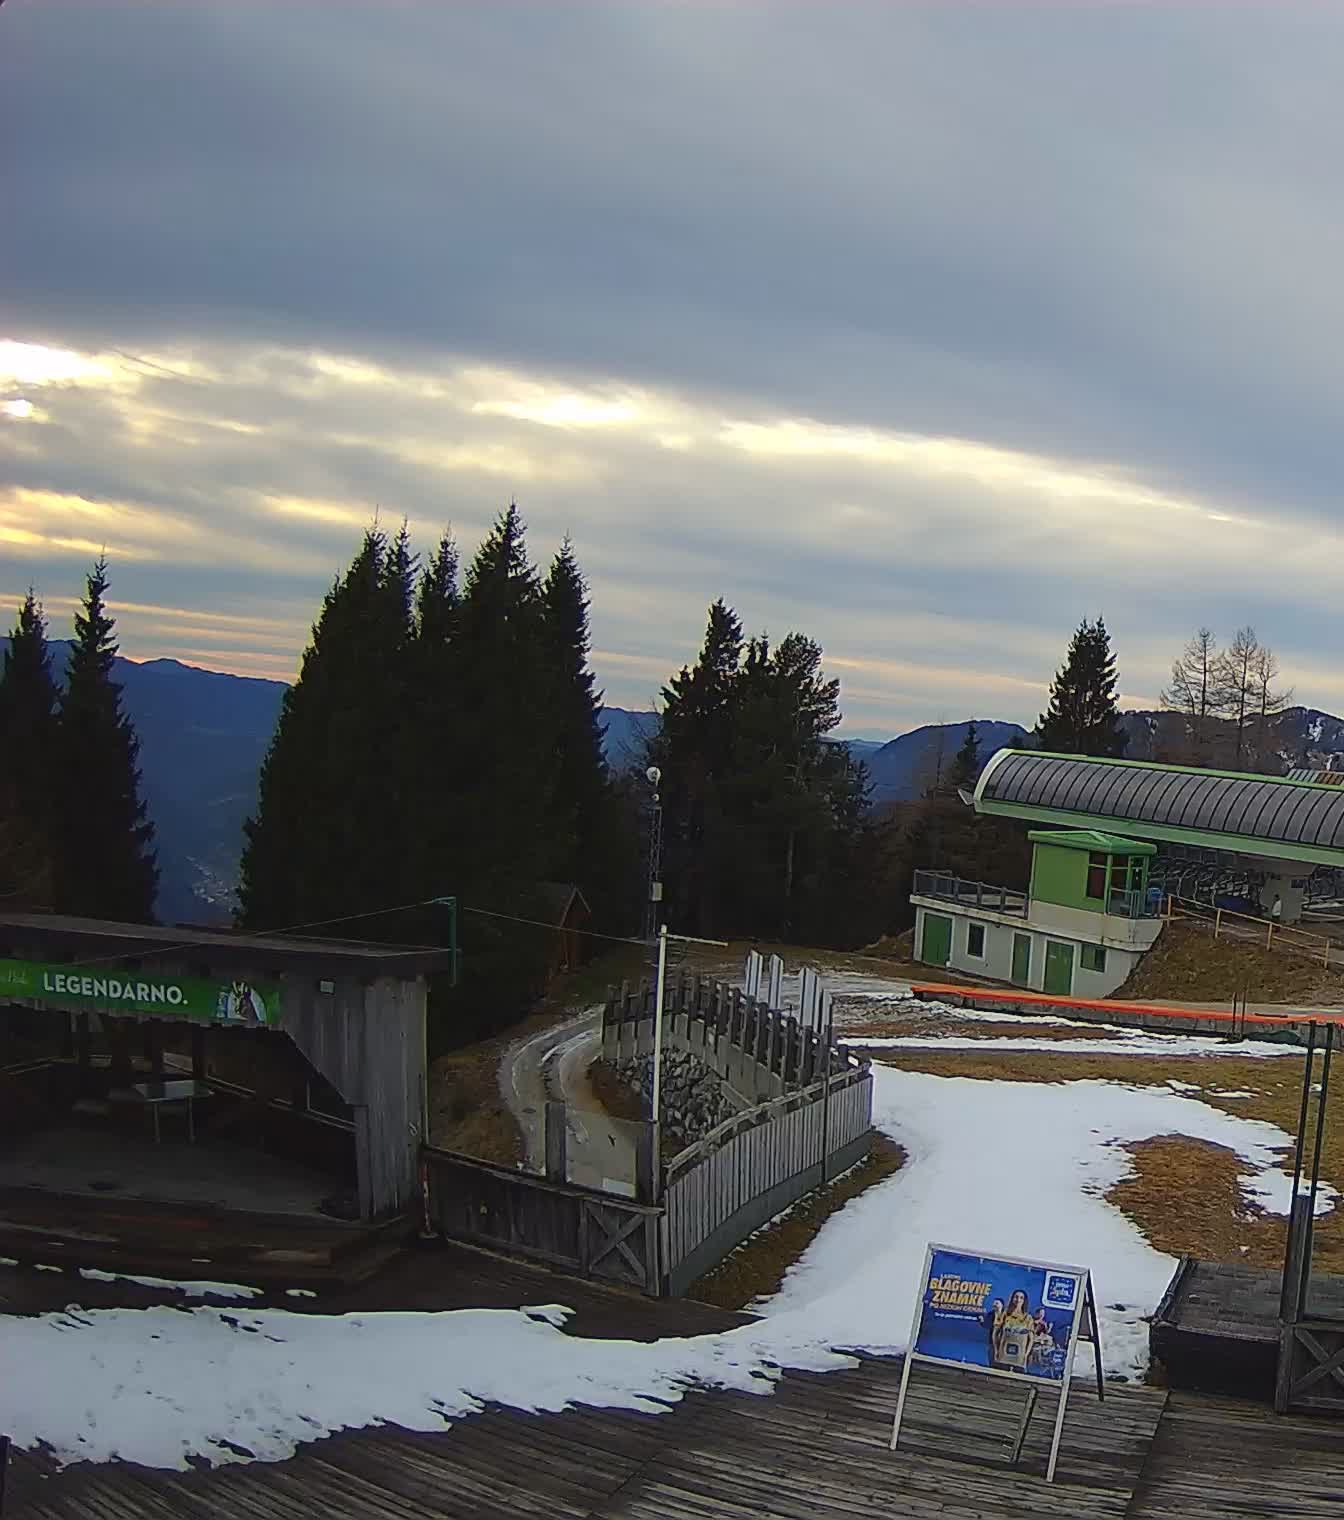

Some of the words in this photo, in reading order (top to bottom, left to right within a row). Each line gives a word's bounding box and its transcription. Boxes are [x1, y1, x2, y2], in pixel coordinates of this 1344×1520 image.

[43, 972, 189, 1005] LEGENDARNO.
[929, 1277, 992, 1296] BLAGOVNE
[932, 1290, 985, 1307] ZNAMKE
